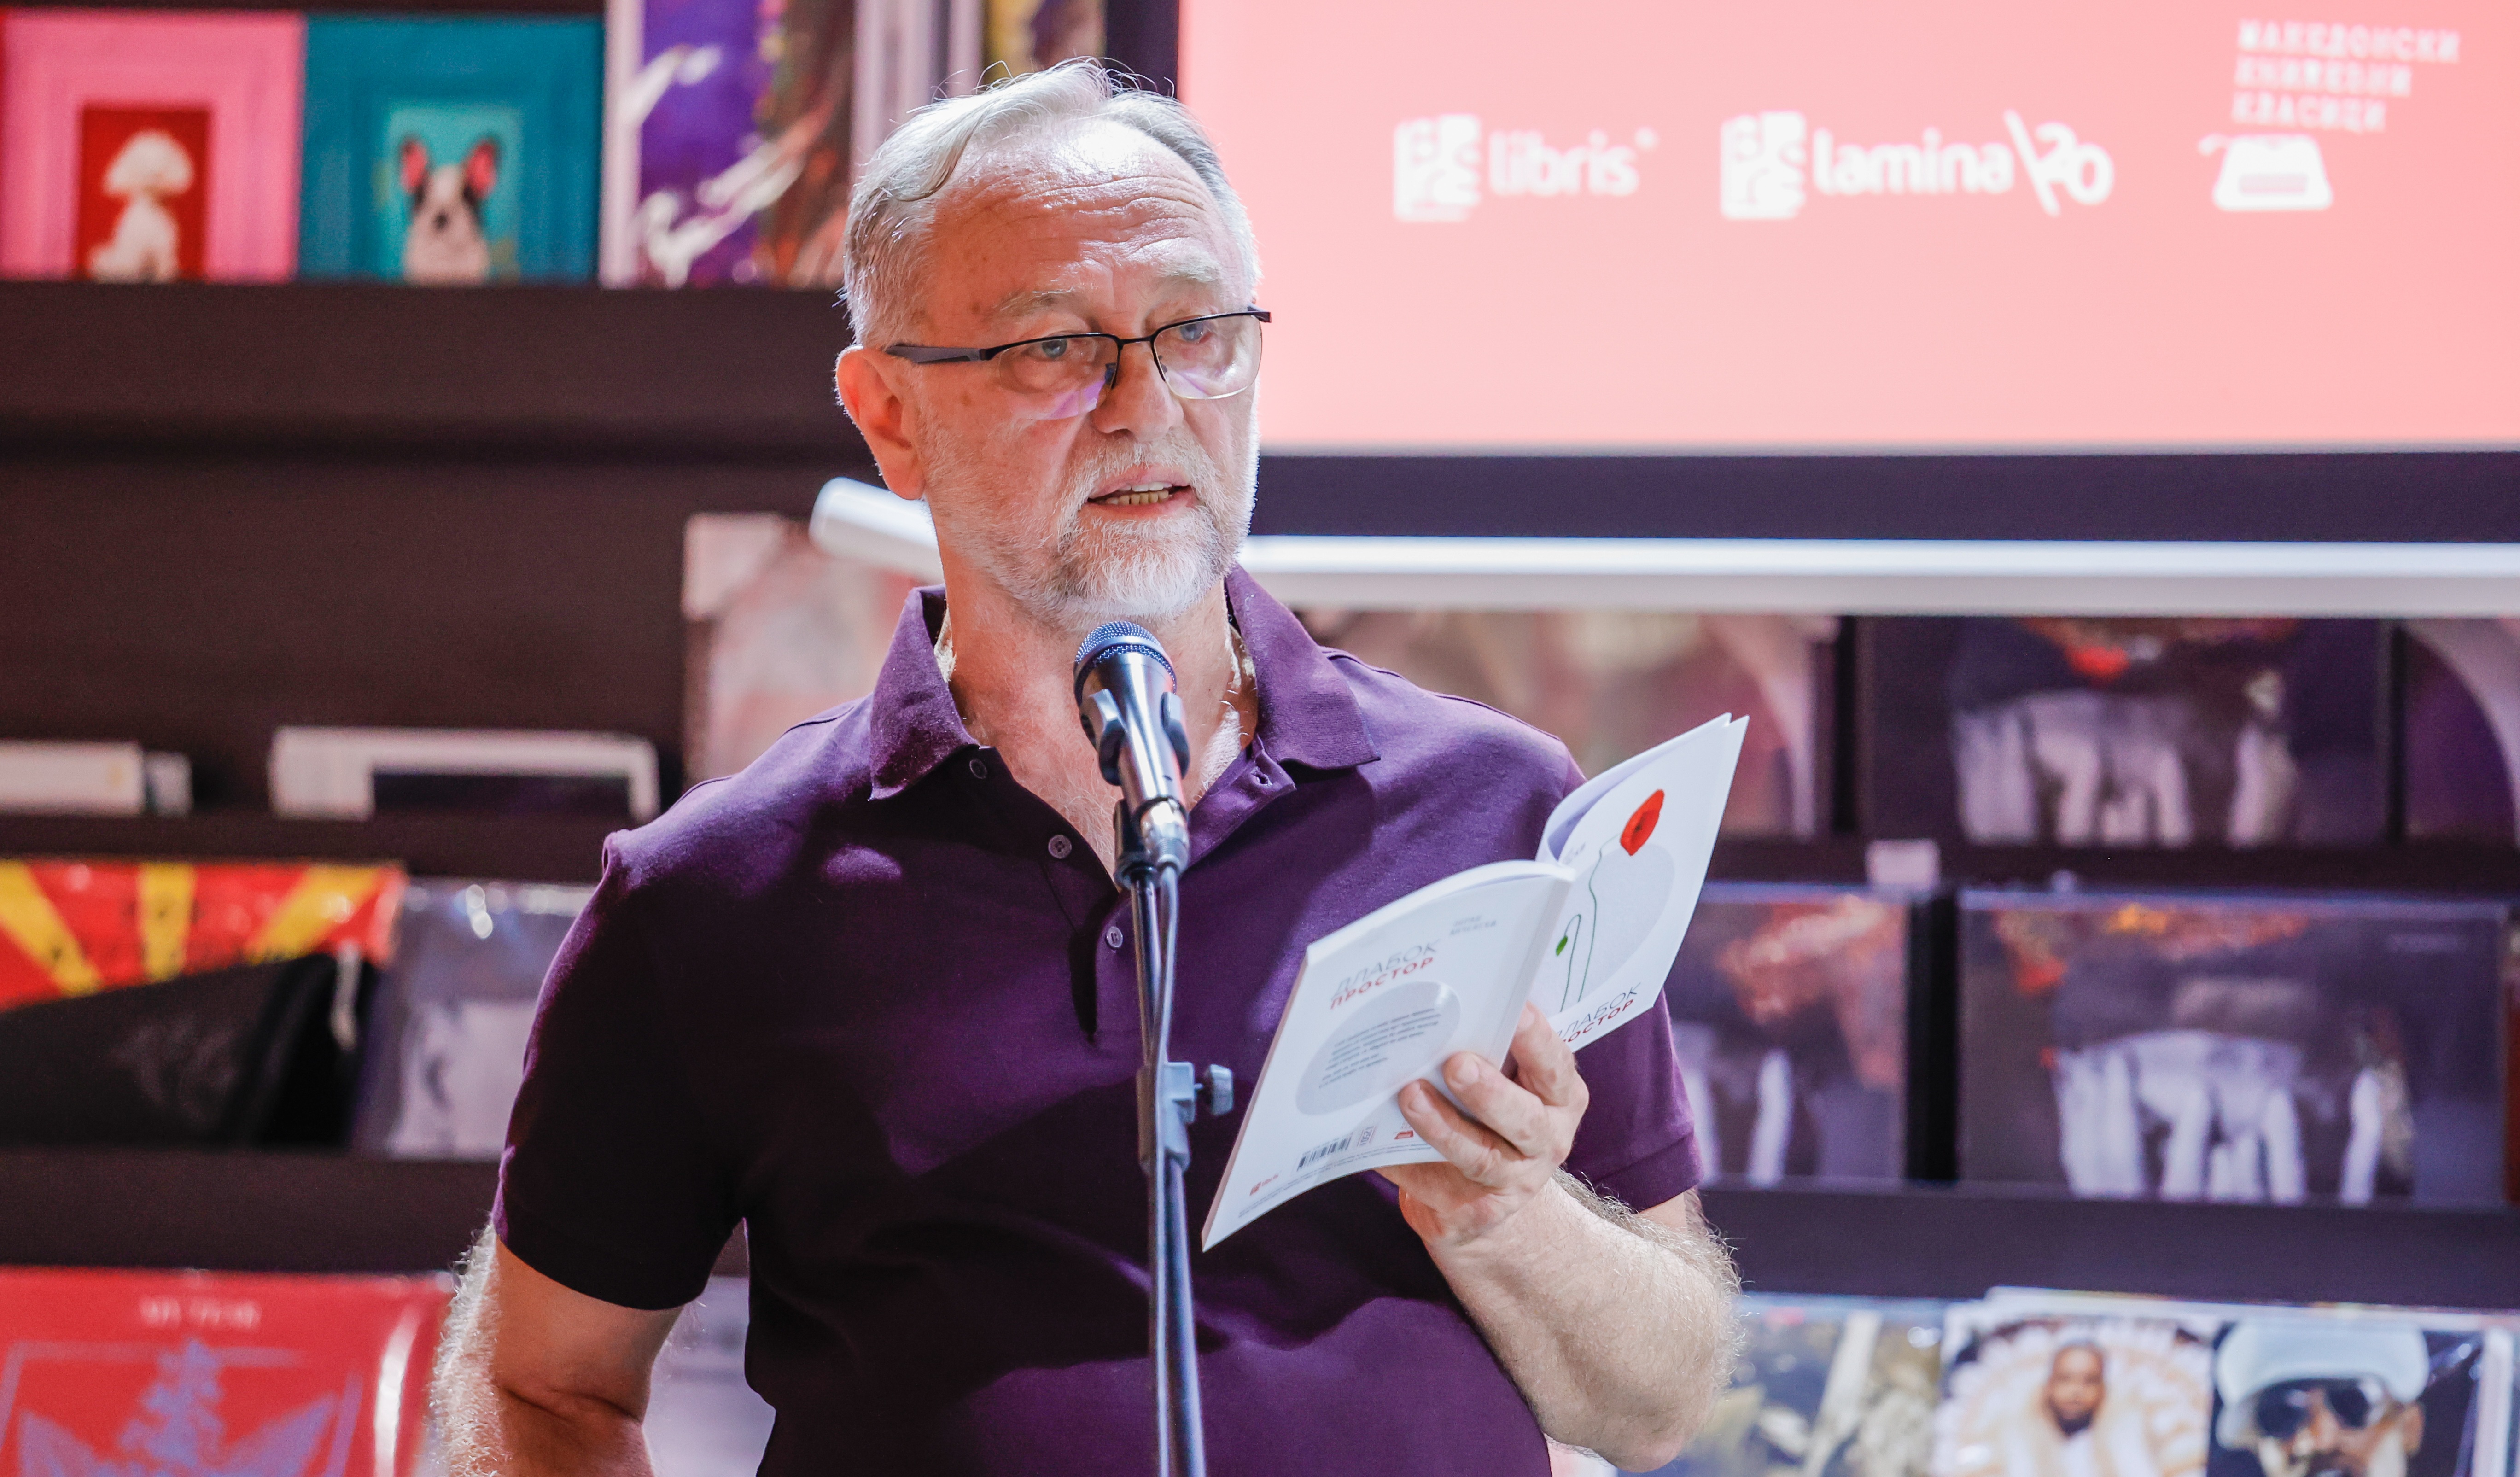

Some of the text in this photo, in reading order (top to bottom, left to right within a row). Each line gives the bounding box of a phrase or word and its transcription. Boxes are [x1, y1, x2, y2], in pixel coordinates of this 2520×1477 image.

[2238, 20, 2460, 63] МАКЕДОНСКИ
[2231, 90, 2386, 133] КЛАСИЦИ
[1330, 939, 1441, 1001] ДЛАБОК
[1330, 957, 1433, 1010] ПРОСТОР
[1563, 999, 1633, 1042] ОСТОР
